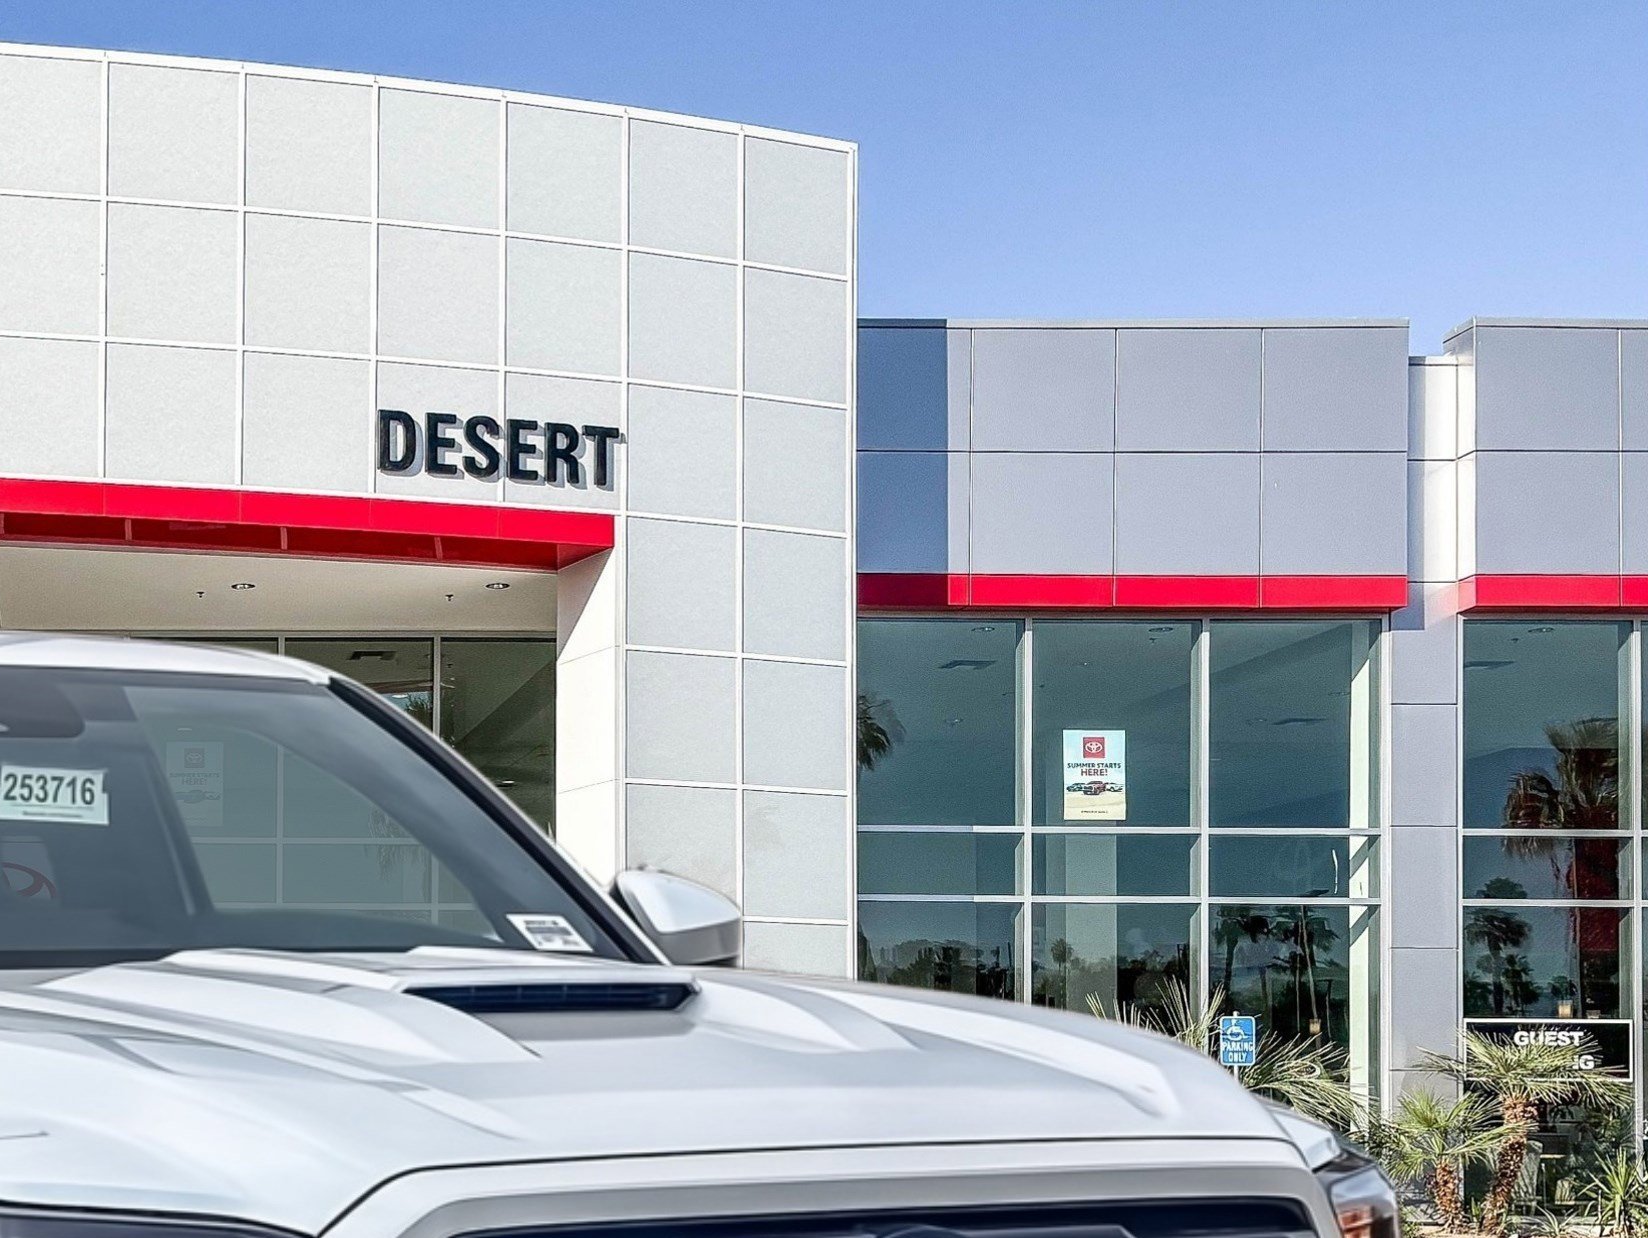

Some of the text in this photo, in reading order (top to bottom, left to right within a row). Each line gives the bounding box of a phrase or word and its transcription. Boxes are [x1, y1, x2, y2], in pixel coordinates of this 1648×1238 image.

[377, 409, 619, 486] DESERT
[3, 773, 95, 805] 253716
[1514, 1031, 1584, 1046] GUEST
[1222, 1042, 1254, 1051] PARKING
[1228, 1052, 1247, 1062] ONLY
